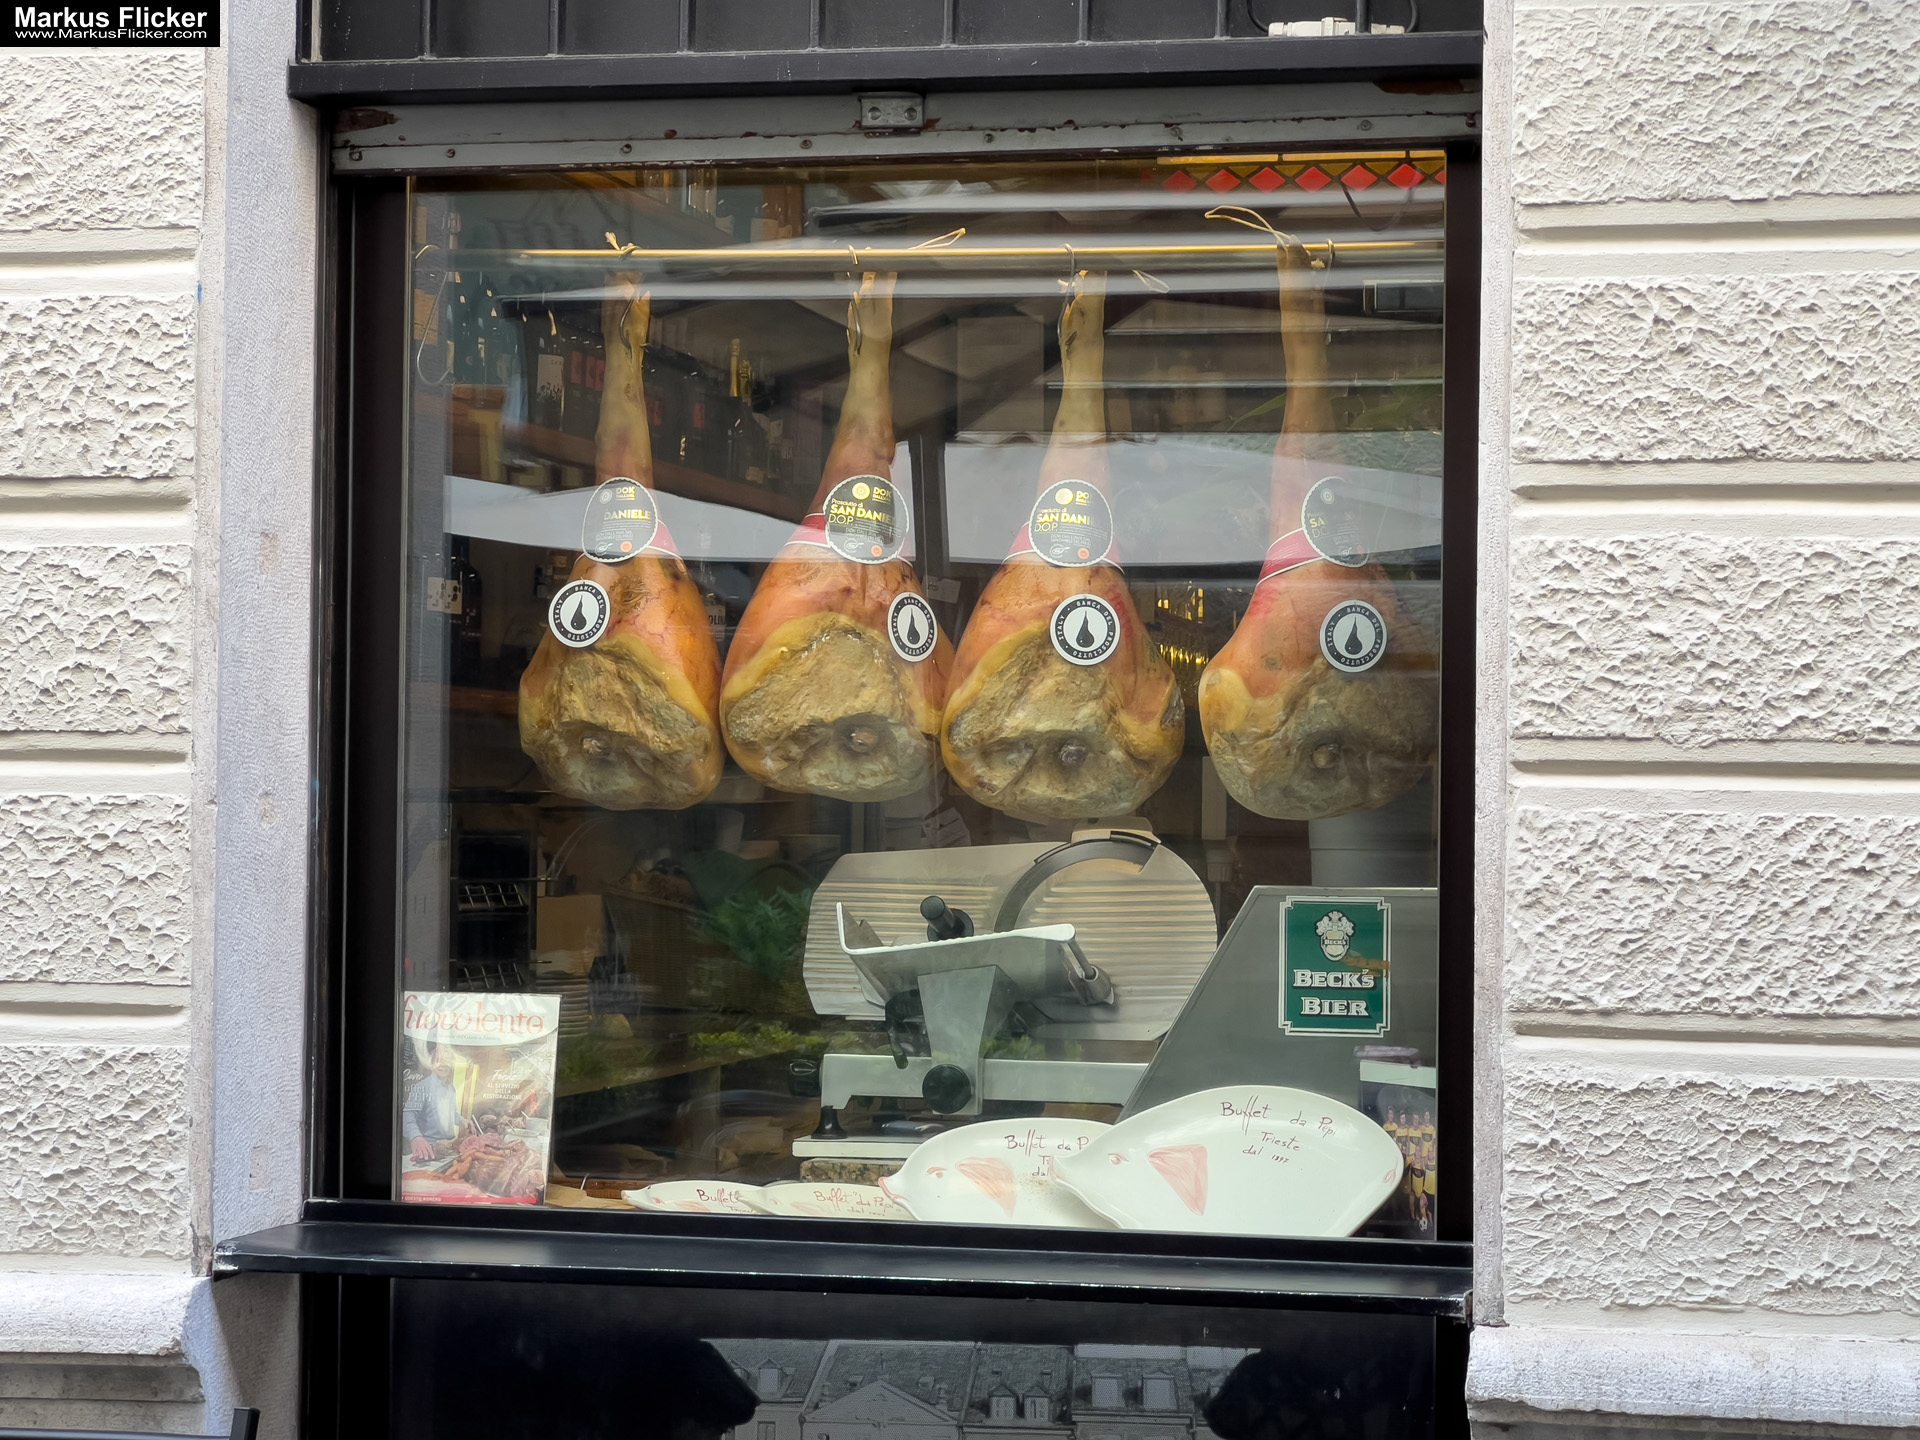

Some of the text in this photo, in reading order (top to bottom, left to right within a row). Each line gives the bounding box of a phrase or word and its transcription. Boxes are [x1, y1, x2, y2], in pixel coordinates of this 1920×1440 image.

[830, 503, 857, 517] SAN
[1036, 512, 1060, 523] SAN
[554, 586, 605, 641] BANCA DEL PROSCIUTTO ITALY
[903, 598, 922, 608] BANCA
[923, 609, 932, 624] DEL
[1057, 600, 1114, 658] BANCA DEL PROSCIUTTO ITALY
[1326, 606, 1382, 666] BANCA DEL PROSCIUTTO ITALY
[904, 629, 934, 655] PROSCIUTTO
[1220, 1094, 1336, 1139] Buffet da Pepi
[1004, 1128, 1047, 1157] Buffet
[1057, 1138, 1072, 1152] da
[1242, 1144, 1264, 1156] dal
[1261, 1131, 1301, 1152] Trieste
